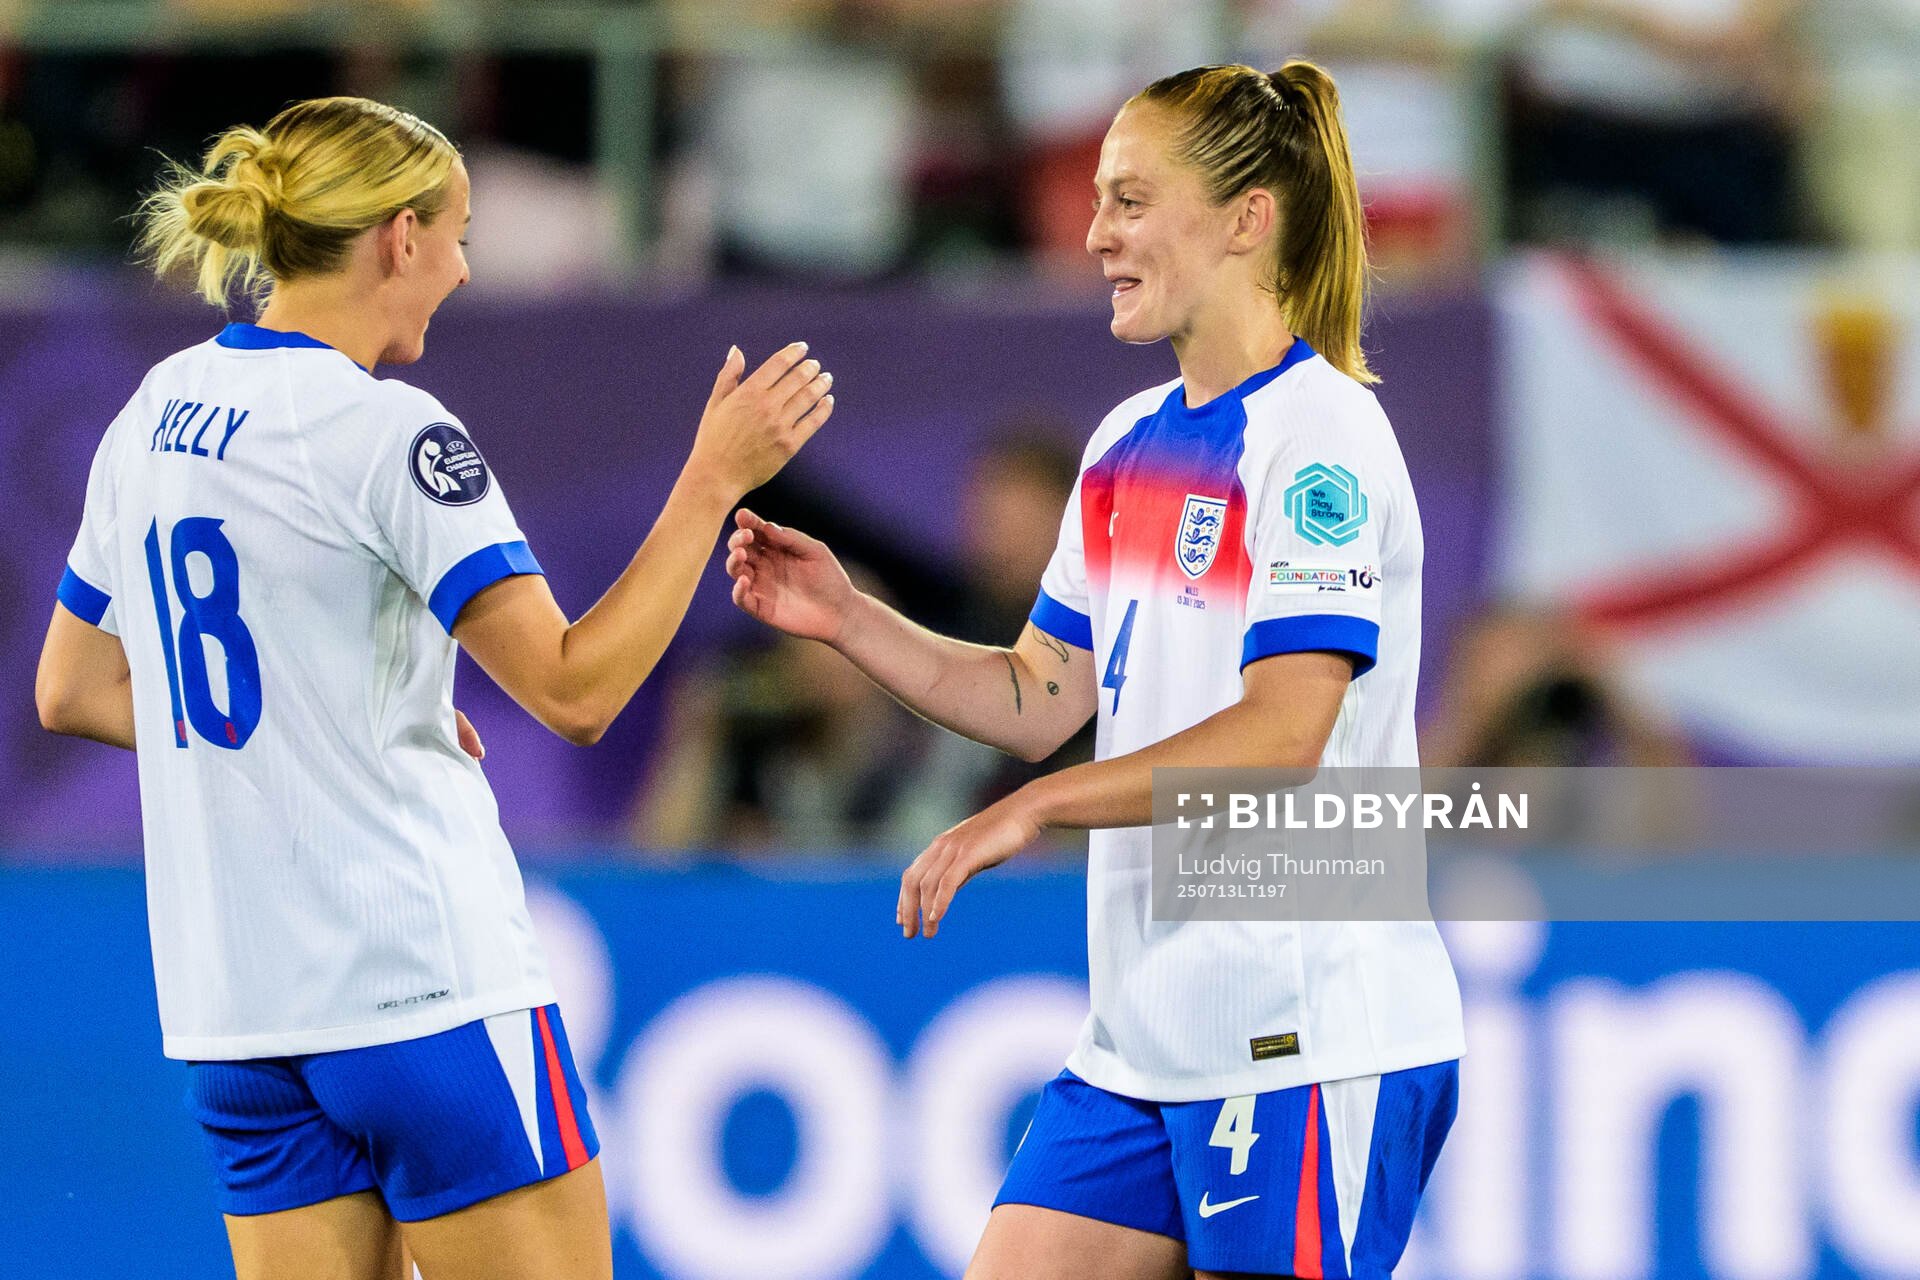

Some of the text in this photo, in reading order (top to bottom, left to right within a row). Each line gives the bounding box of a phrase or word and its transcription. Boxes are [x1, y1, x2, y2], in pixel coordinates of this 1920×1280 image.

[150, 398, 250, 461] KELLY
[459, 468, 481, 479] 2022
[1311, 489, 1326, 498] We
[1311, 499, 1333, 511] Play
[1311, 509, 1344, 522] Strong
[144, 514, 262, 750] 18
[1101, 599, 1139, 717] 4
[1208, 1094, 1260, 1175] 4
